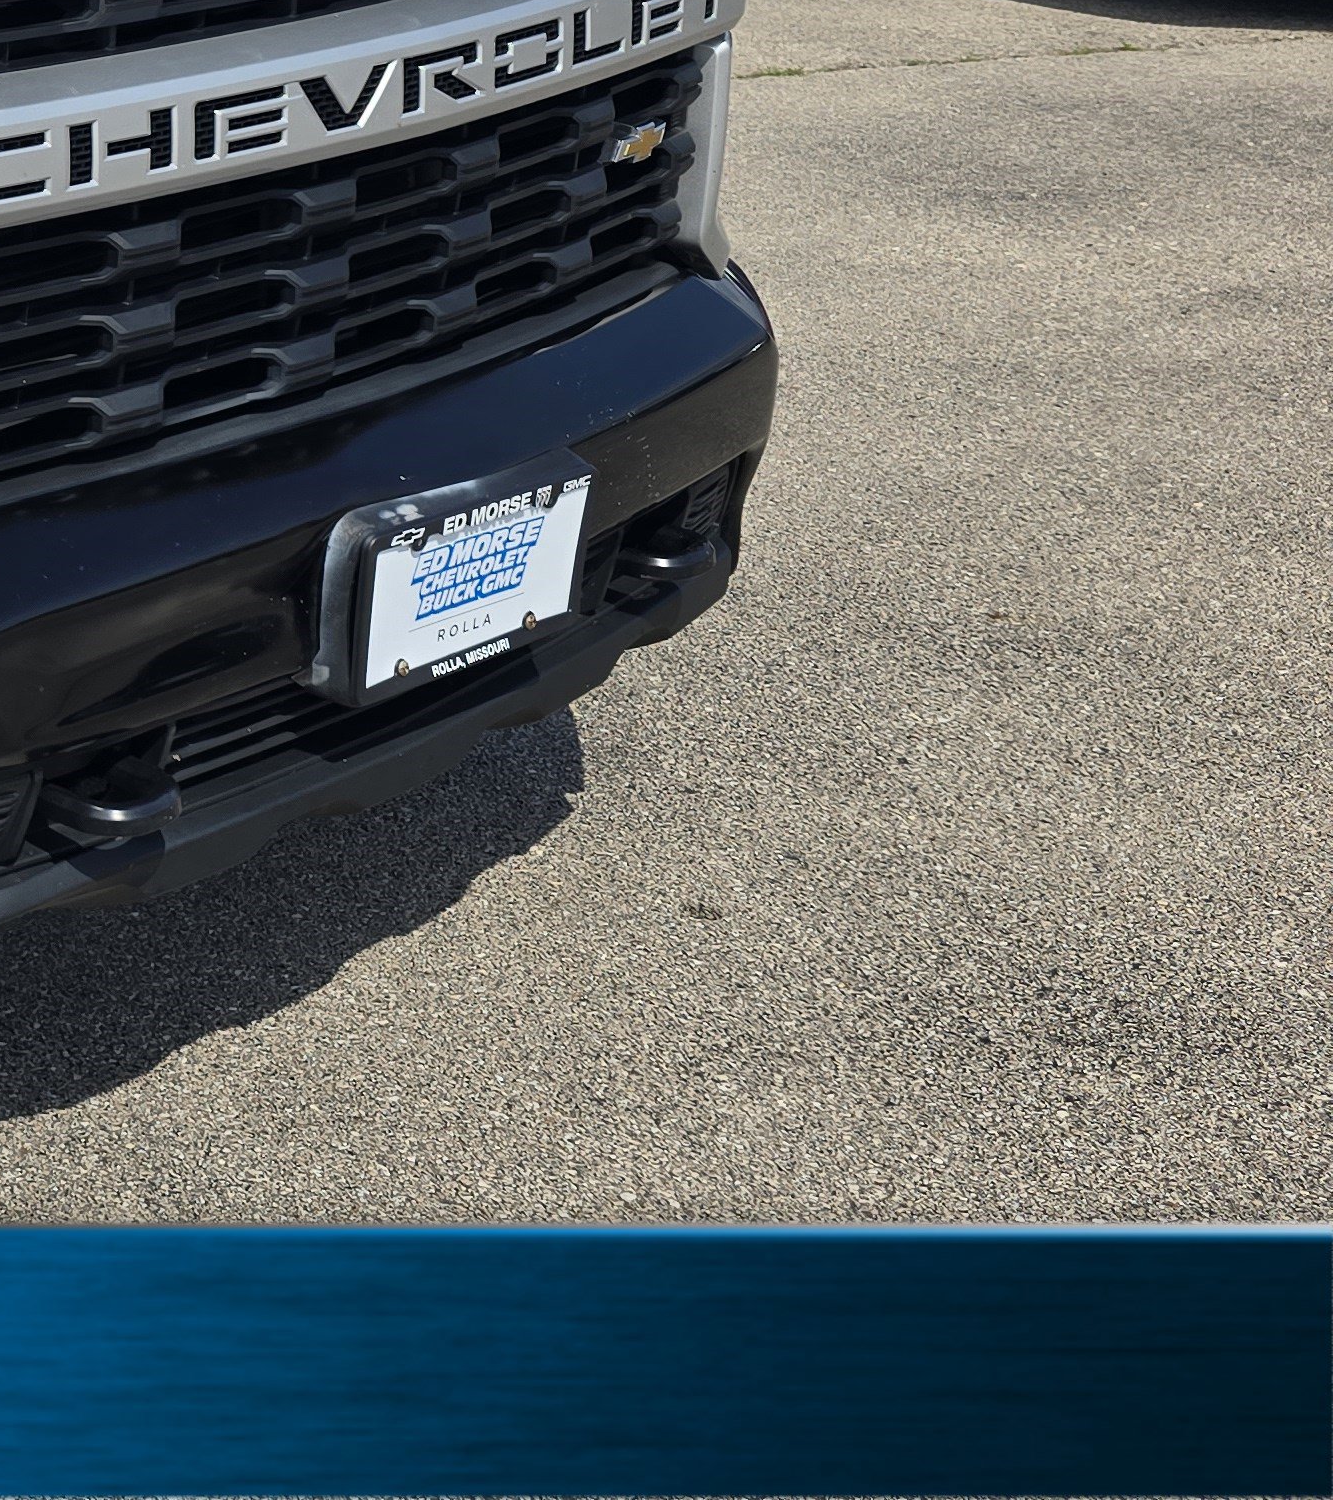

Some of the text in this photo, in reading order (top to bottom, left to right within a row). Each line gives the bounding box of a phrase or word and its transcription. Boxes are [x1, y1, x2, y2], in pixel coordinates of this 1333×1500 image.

[562, 475, 592, 493] GMC
[442, 492, 533, 536] ED MORSE
[414, 518, 543, 580] ED MORSE
[419, 546, 530, 597] CHEVROLET
[436, 613, 492, 642] ROLLA
[431, 637, 511, 678] ROLLA, MISSOURI
